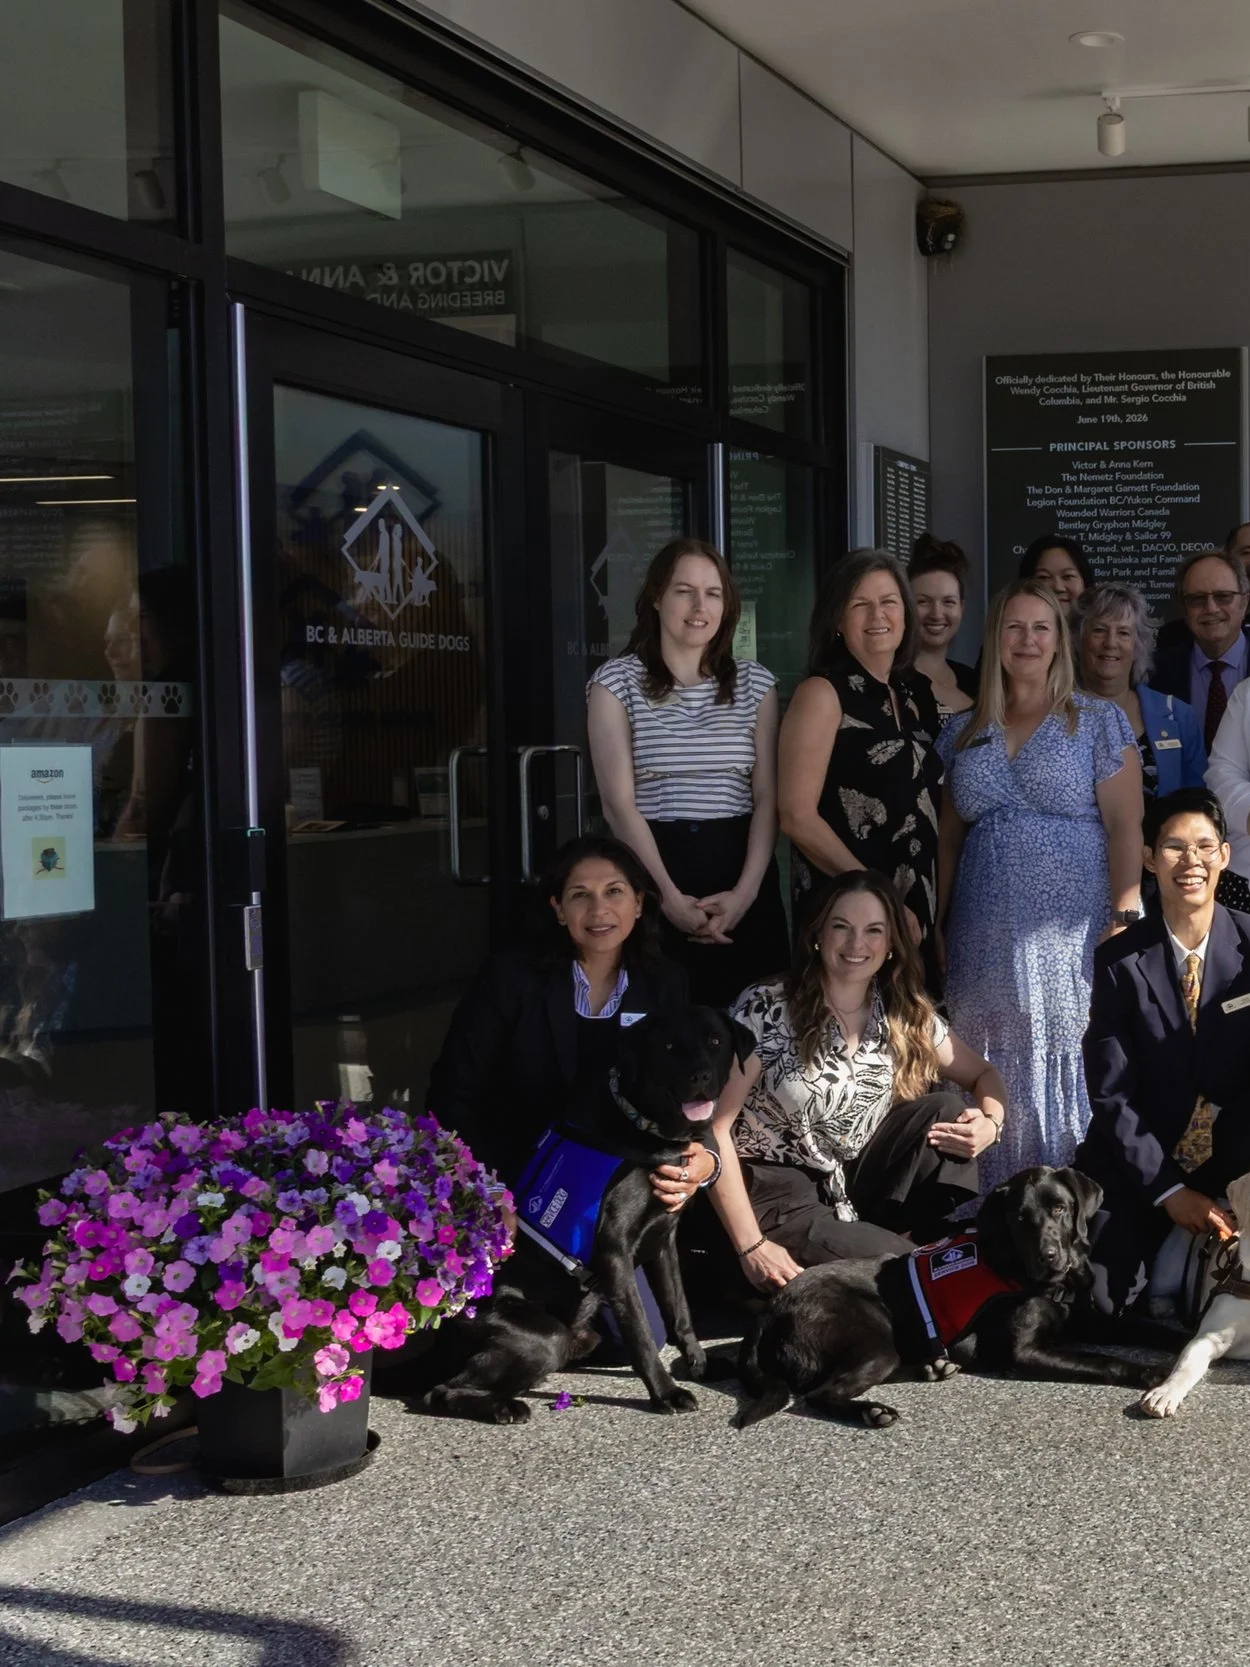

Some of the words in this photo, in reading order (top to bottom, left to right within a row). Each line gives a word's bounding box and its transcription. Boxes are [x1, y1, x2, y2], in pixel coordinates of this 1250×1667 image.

[995, 376, 1033, 386] Officially
[1035, 374, 1077, 383] dedicated
[1081, 373, 1092, 384] by
[1094, 373, 1115, 381] Their
[1119, 372, 1159, 381] Honours,
[1161, 371, 1175, 379] the
[1179, 369, 1230, 379] Honourable
[1010, 386, 1041, 397] Wendy
[1043, 385, 1080, 395] Cocchia,
[1082, 384, 1128, 393] Lieutenant
[1131, 383, 1173, 391] Governor
[1176, 382, 1185, 390] of
[1188, 381, 1216, 389] British
[1039, 397, 1083, 406] Columbia,
[1085, 396, 1101, 404] and
[1121, 395, 1149, 405] Sergio
[1152, 394, 1187, 402] Cocchia
[1077, 416, 1098, 424] June
[1101, 415, 1123, 423] 19th,
[1126, 414, 1148, 422] 2026
[1050, 442, 1109, 451] PRINCIPAL
[1113, 440, 1176, 450] SPONSORS
[1072, 461, 1097, 469] Victor
[1100, 461, 1107, 469] &
[1109, 460, 1130, 468] Anna
[1133, 460, 1153, 468] Kern
[1061, 473, 1077, 481] The
[1080, 473, 1113, 481] Nemetz
[1116, 471, 1164, 480] Foundation
[1026, 486, 1042, 494] The
[1045, 485, 1062, 494] Don
[1074, 485, 1113, 495] Margaret
[1151, 483, 1199, 491] Foundation
[1027, 498, 1055, 508] Legion
[1058, 497, 1107, 505] Foundation
[1110, 496, 1152, 505] BC/Yukon
[1155, 495, 1200, 503] Command
[1056, 509, 1097, 518] Wounded
[1100, 508, 1135, 517] Warriors
[1137, 508, 1170, 516] Canada
[1059, 521, 1090, 531] Bentley
[1093, 521, 1129, 531] Gryphon
[1132, 520, 1167, 530] Midgley
[1088, 532, 1123, 542] Midgley
[1135, 532, 1158, 540] Sailor
[1161, 531, 1171, 539] 99
[1083, 544, 1095, 552] Dr.
[1141, 554, 1157, 563] and
[1159, 553, 1184, 562] Famil
[1113, 567, 1132, 575] Park
[1134, 567, 1150, 575] and
[1153, 566, 1176, 575] Famil
[306, 625, 324, 643] BC
[328, 627, 337, 644] &
[341, 627, 395, 647] ALBERTA
[399, 632, 436, 649] GUIDE
[439, 635, 470, 650] DOGS
[31, 769, 64, 778] amazon
